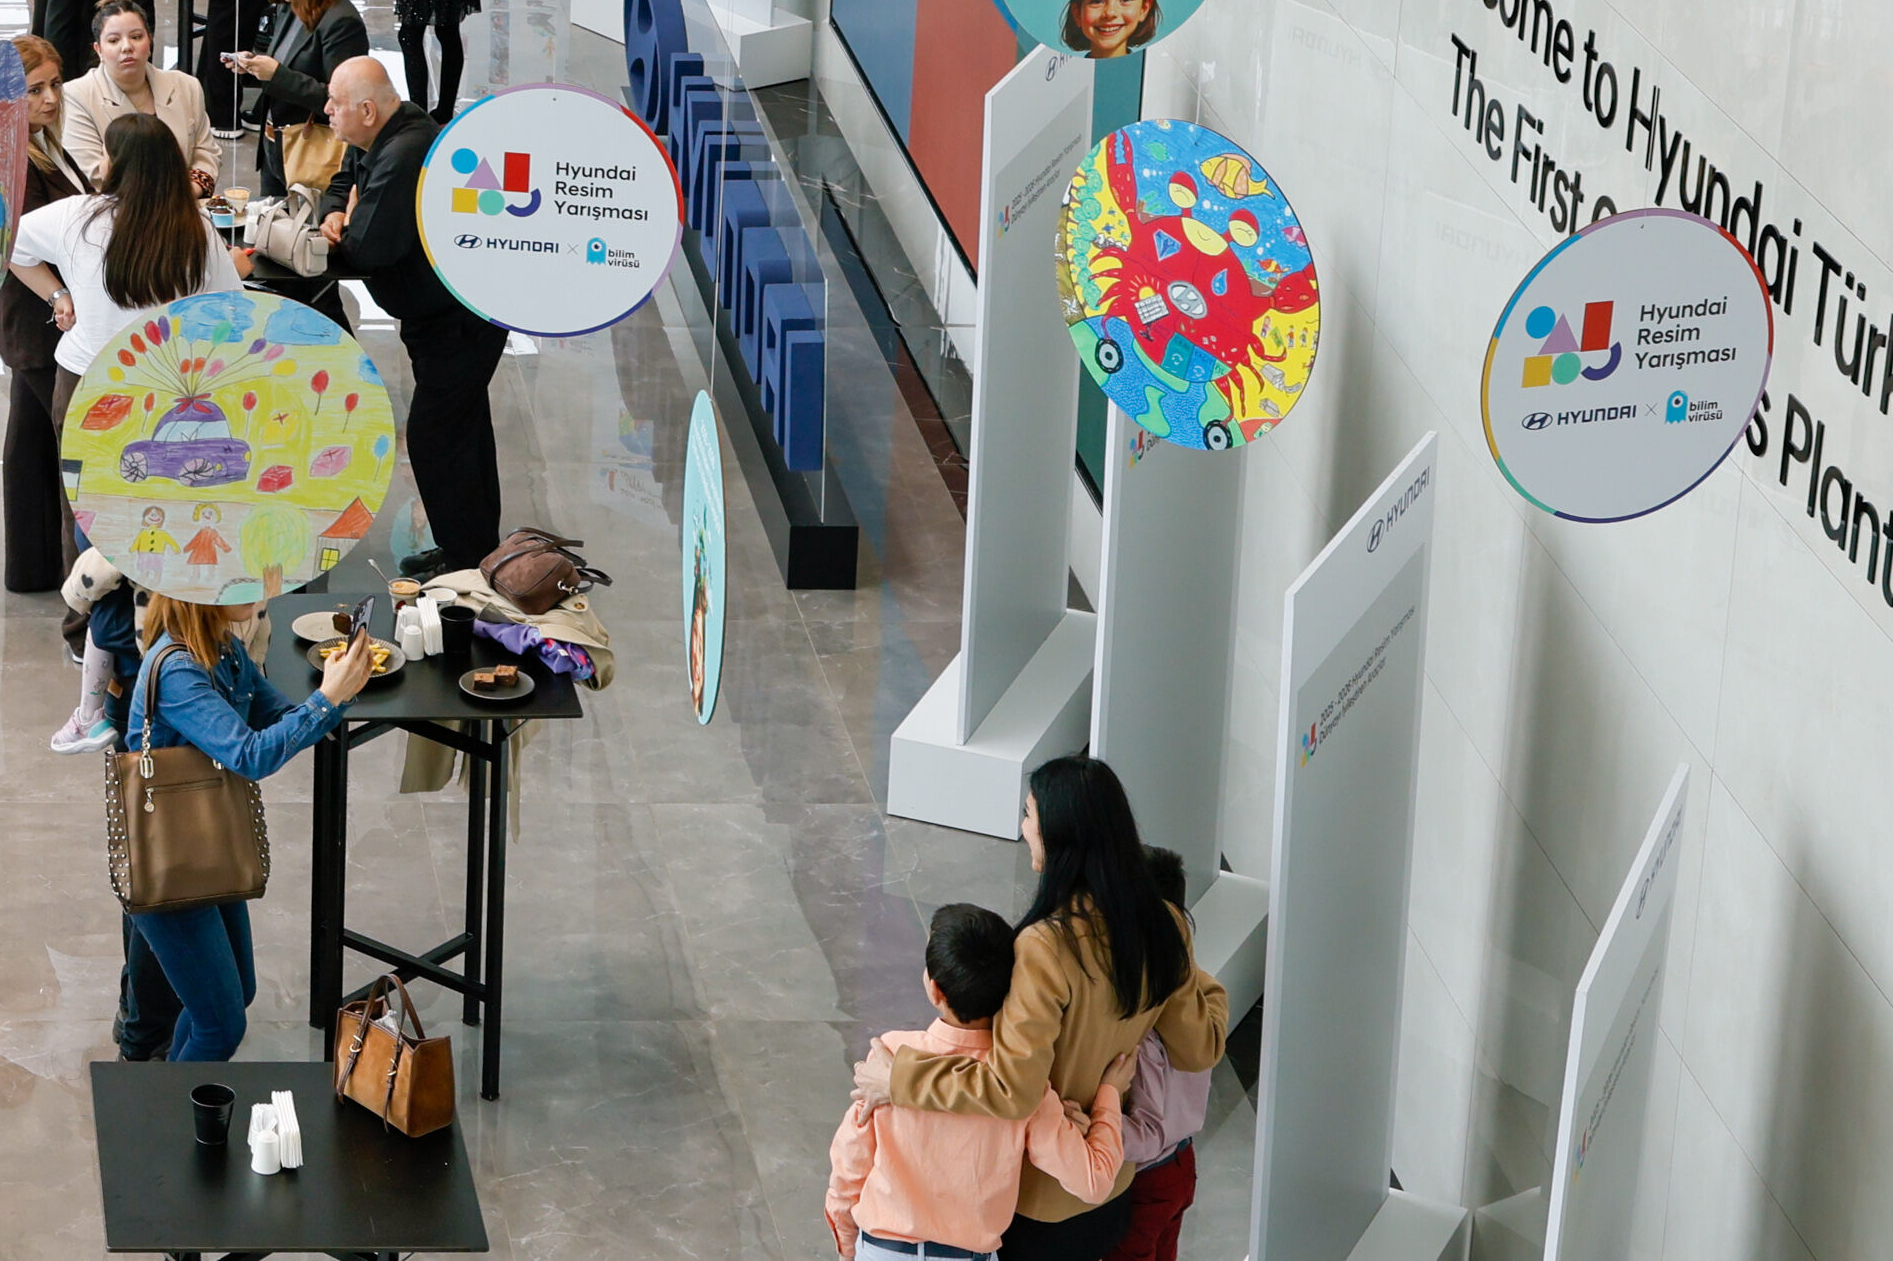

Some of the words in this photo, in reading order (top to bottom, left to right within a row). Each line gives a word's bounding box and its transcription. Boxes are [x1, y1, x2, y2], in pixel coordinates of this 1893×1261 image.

[1450, 32, 1506, 162] The
[1510, 103, 1585, 236] First
[556, 161, 636, 181] Hyundai
[1582, 29, 1619, 130] to
[1625, 66, 1803, 317] Hyundai
[555, 181, 613, 199] Resim
[554, 201, 648, 221] Yarışması
[487, 238, 559, 253] HYUNDAI
[608, 249, 635, 259] bilim
[608, 259, 640, 269] virüsü
[1639, 296, 1727, 325] Hyundai
[1637, 324, 1700, 346] Resim
[1635, 347, 1737, 370] Yarışması
[1557, 405, 1637, 425] HYUNDAI
[1689, 400, 1718, 412] bilim
[1688, 410, 1723, 423] virüsü
[1385, 465, 1430, 533] HYUNDAI
